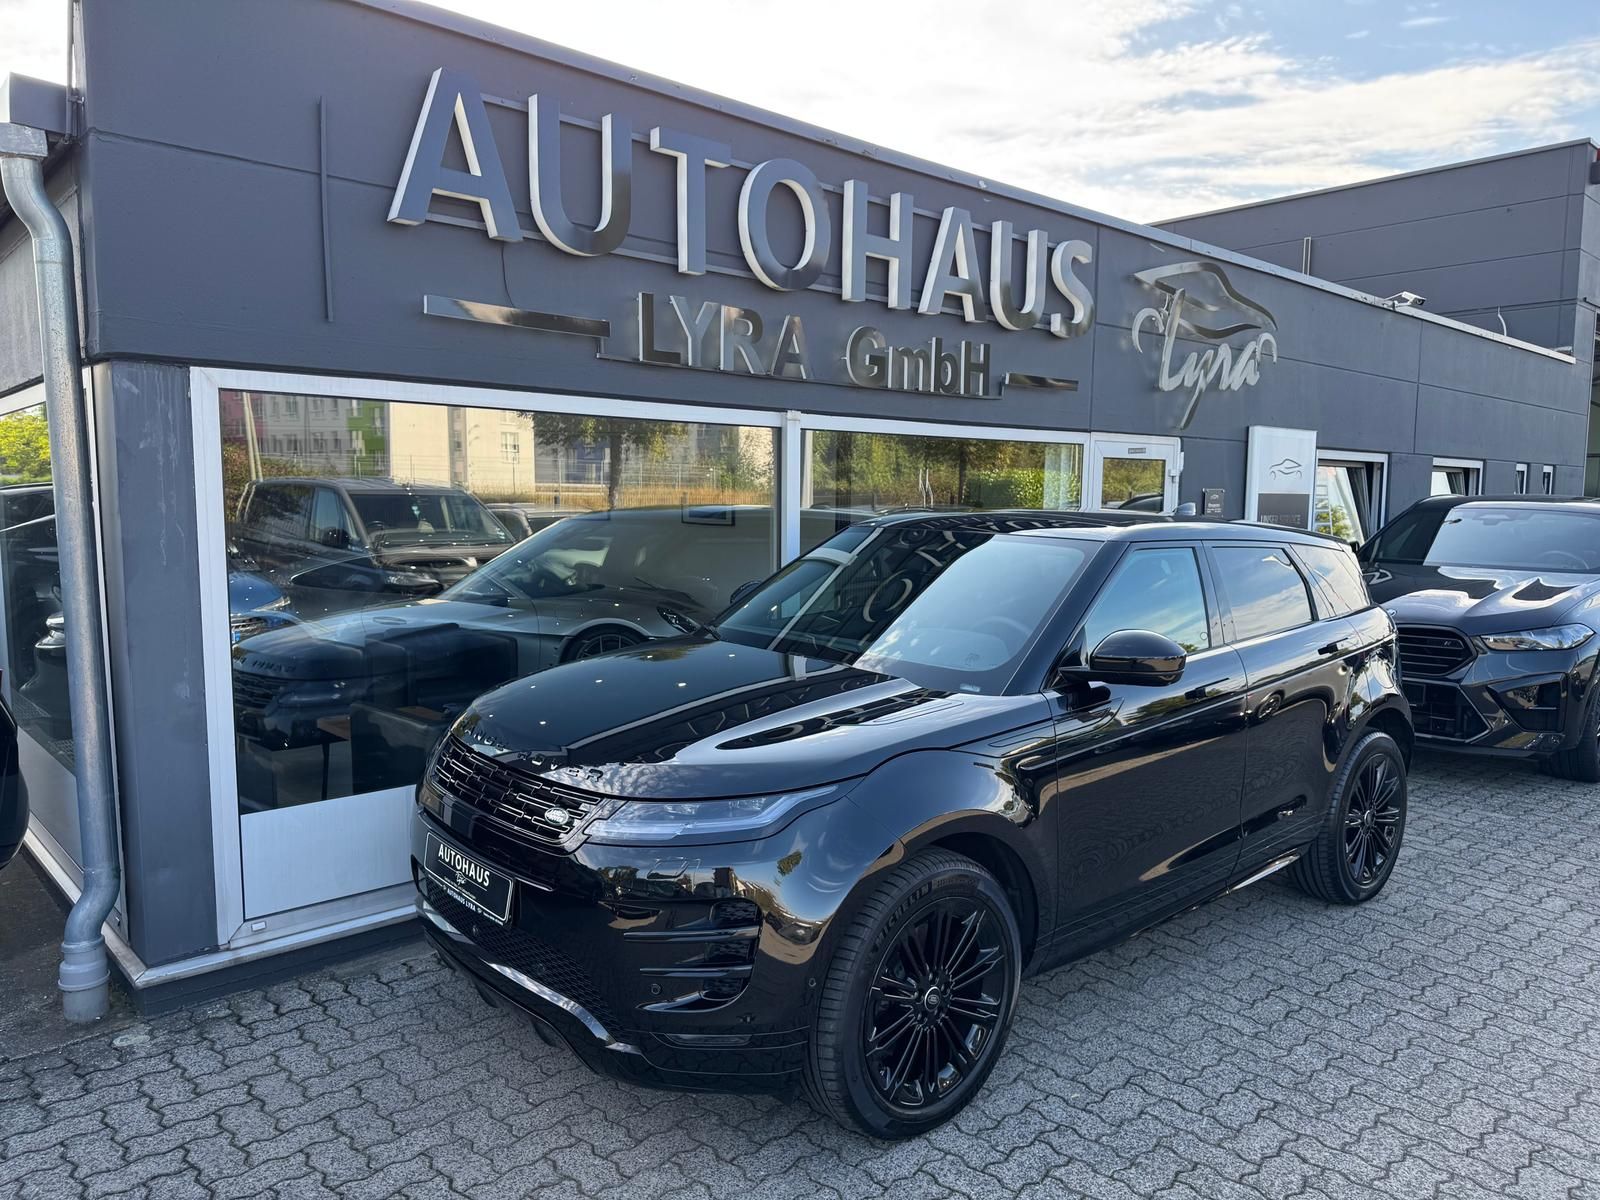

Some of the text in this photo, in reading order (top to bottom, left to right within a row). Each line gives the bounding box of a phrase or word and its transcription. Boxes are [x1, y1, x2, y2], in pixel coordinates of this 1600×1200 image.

[387, 67, 1094, 339] AUTOHAUS
[637, 291, 991, 396] LYRA GmbH
[517, 751, 604, 783] ROVER
[438, 843, 490, 887] AUTOHAUS
